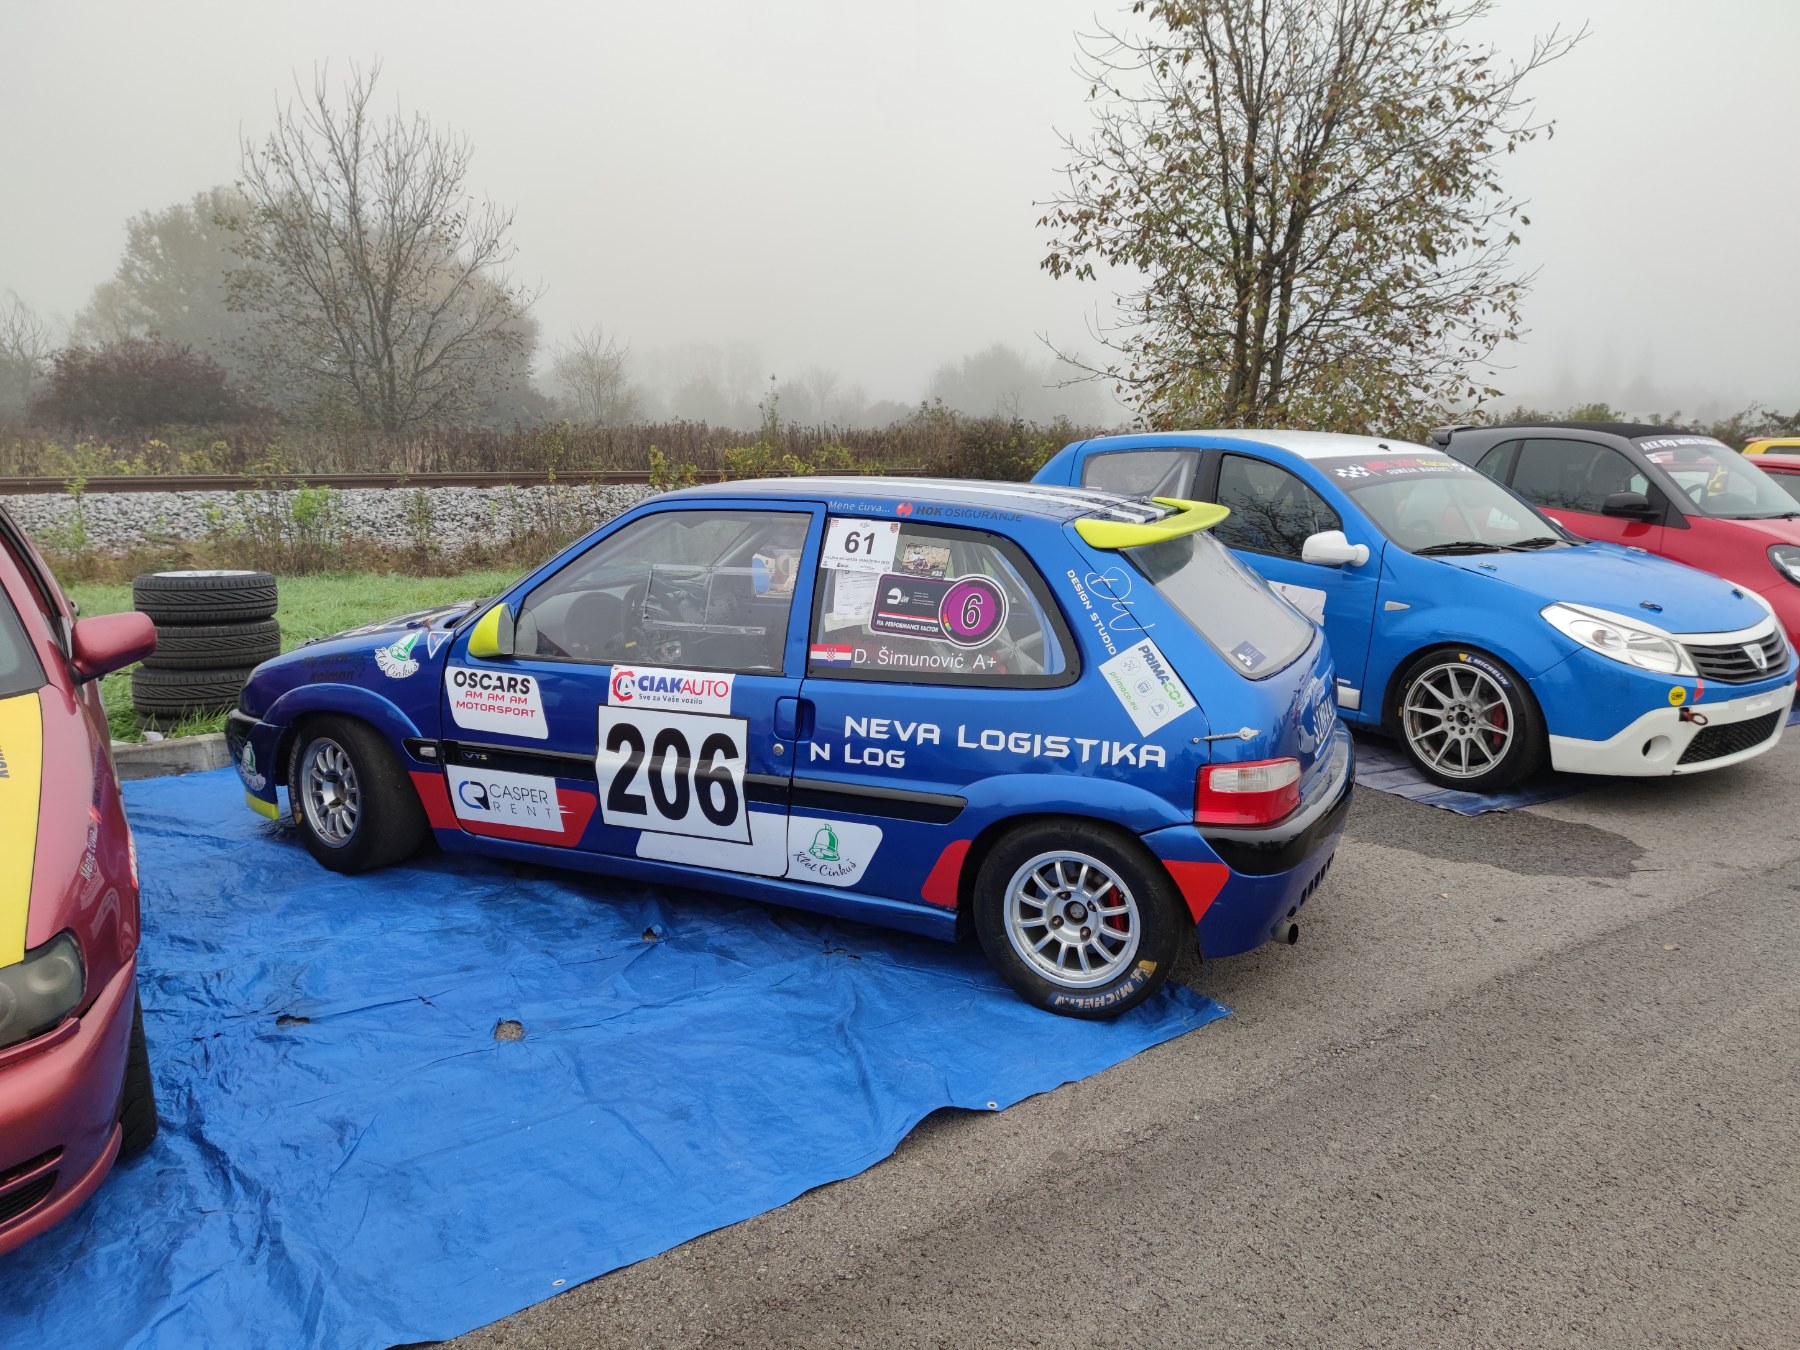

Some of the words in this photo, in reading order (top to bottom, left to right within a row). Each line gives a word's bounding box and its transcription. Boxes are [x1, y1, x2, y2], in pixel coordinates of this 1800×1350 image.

[828, 500, 855, 511] Mene
[916, 505, 944, 517] HOK
[944, 508, 1023, 522] OSIGURANJE
[844, 531, 876, 555] 61
[961, 593, 983, 630] 6
[1067, 569, 1093, 610] DESIGN
[1090, 612, 1117, 656] STUDIO
[884, 621, 920, 631] PERFORMANCE
[920, 624, 938, 633] FACTOR
[854, 648, 871, 664] D.
[877, 646, 964, 668] Šimunović
[973, 653, 997, 670] A+
[453, 670, 531, 695] OSCARS
[1473, 658, 1509, 685] MICHELIN
[465, 690, 483, 700] AM
[487, 693, 505, 703] AM
[509, 696, 528, 706] AM
[639, 693, 651, 701] Sve
[663, 694, 680, 703] Vaše
[681, 697, 703, 705] vozilo
[1109, 671, 1140, 711] primaco.eu
[456, 700, 536, 718] MOTORSPORT
[845, 715, 940, 746] NEVA
[957, 724, 1166, 769] LOGISTIKA
[810, 742, 830, 763] N
[844, 744, 906, 769] LOG
[606, 723, 739, 827] 206
[489, 784, 548, 805] CASPER
[80, 851, 95, 882] Mene
